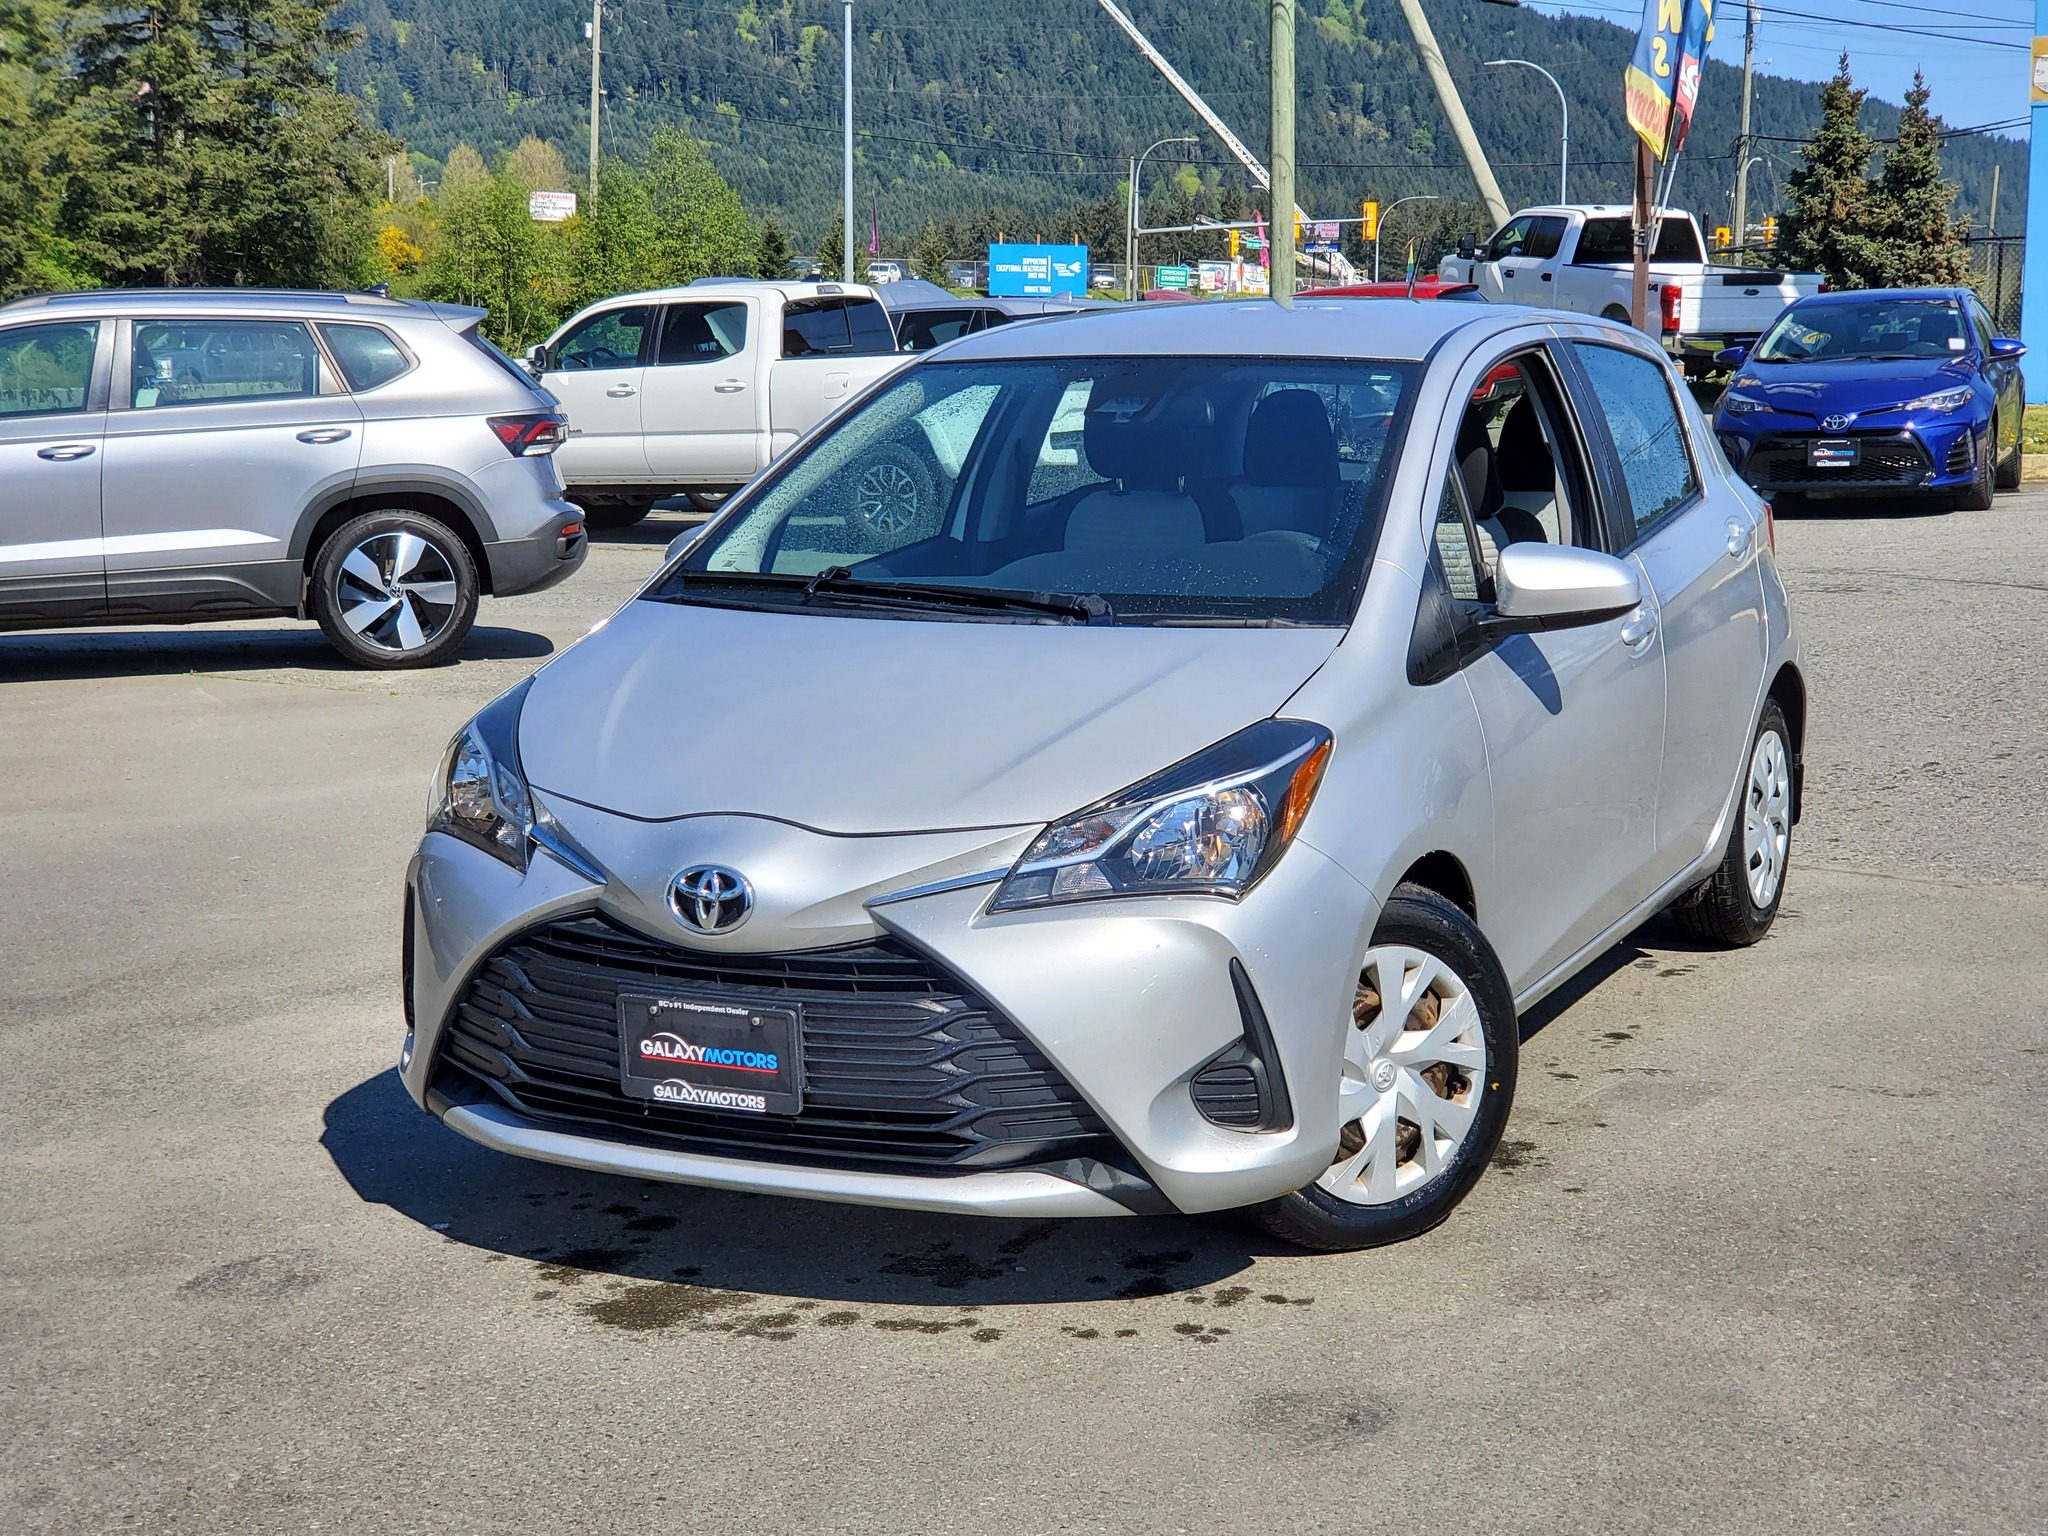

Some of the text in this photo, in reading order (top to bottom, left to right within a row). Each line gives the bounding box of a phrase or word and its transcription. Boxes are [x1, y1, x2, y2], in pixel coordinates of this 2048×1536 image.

[995, 264, 1022, 272] EXCEPTIONAL
[1023, 265, 1047, 273] HEALTHCARE
[1023, 285, 1038, 293] DONATE
[658, 1000, 673, 1008] BC's
[683, 1002, 726, 1014] Independent
[726, 1006, 749, 1016] Dealer
[653, 1084, 766, 1109] GALAXYMOTORS
